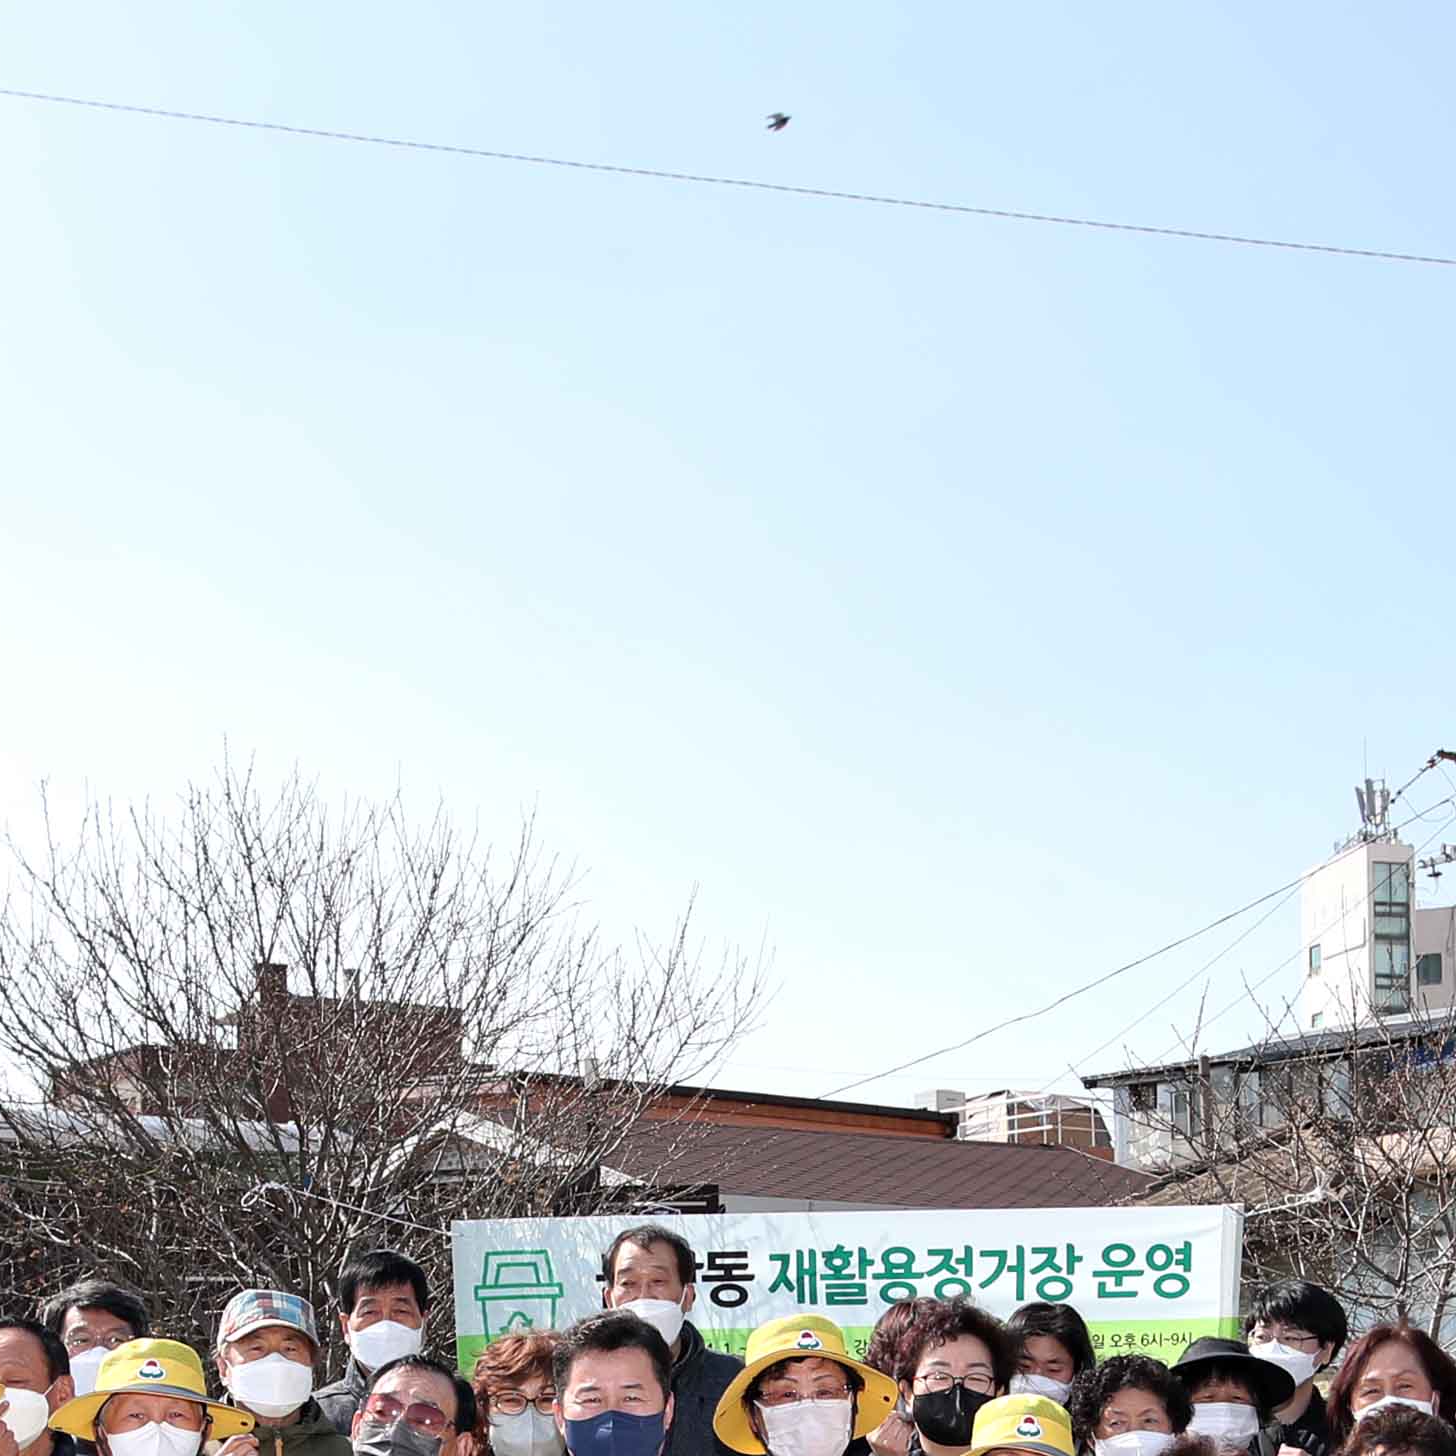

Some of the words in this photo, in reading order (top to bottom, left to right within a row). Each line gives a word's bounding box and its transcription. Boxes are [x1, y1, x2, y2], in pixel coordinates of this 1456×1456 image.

[769, 1243, 1082, 1306] 재활용정거장
[1092, 1241, 1193, 1299] 운영
[1110, 1333, 1136, 1349] 오후
[1141, 1332, 1192, 1347] 6시~9시
